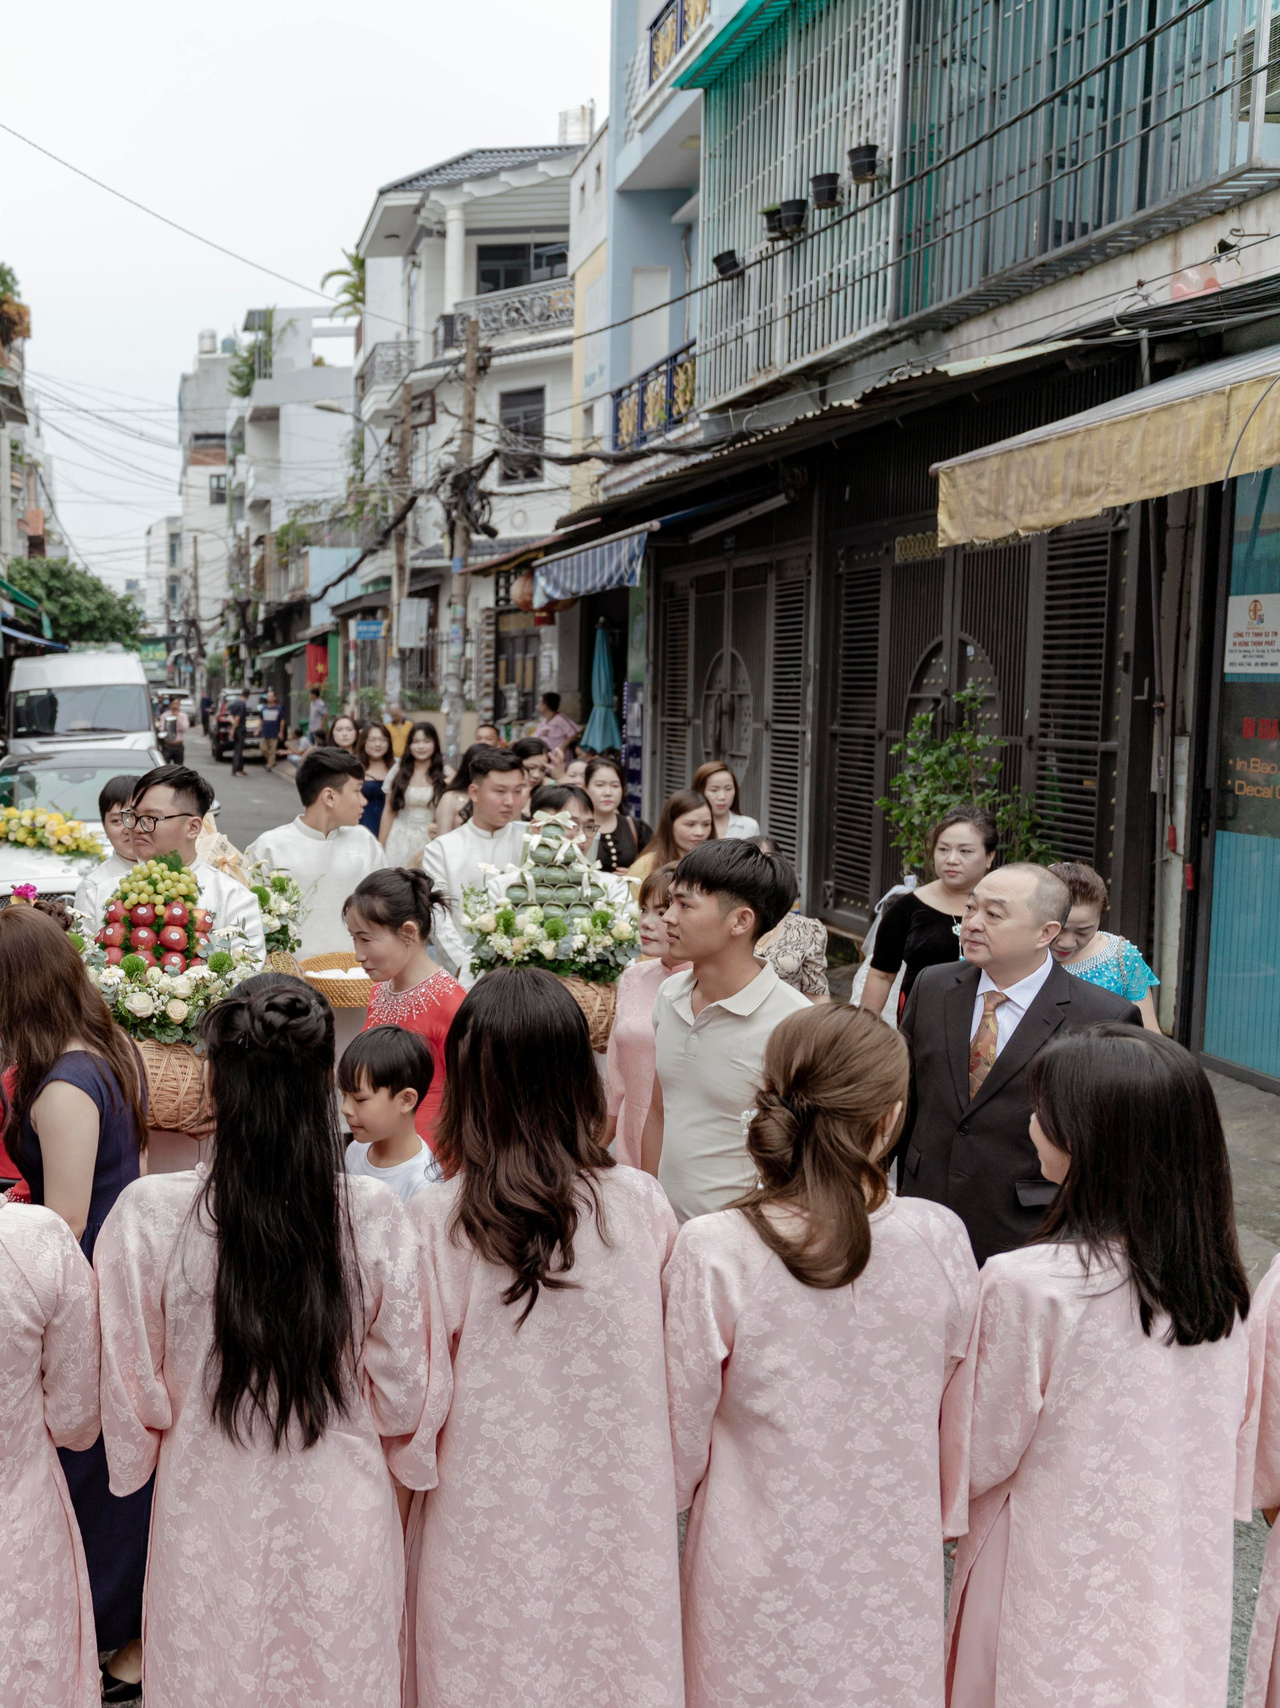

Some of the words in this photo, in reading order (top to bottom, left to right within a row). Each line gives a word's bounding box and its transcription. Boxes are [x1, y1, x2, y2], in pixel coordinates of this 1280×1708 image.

[1242, 717, 1256, 739] IN
[1258, 718, 1278, 740] GIA
[1236, 757, 1248, 771] In
[1235, 780, 1273, 799] Decal
